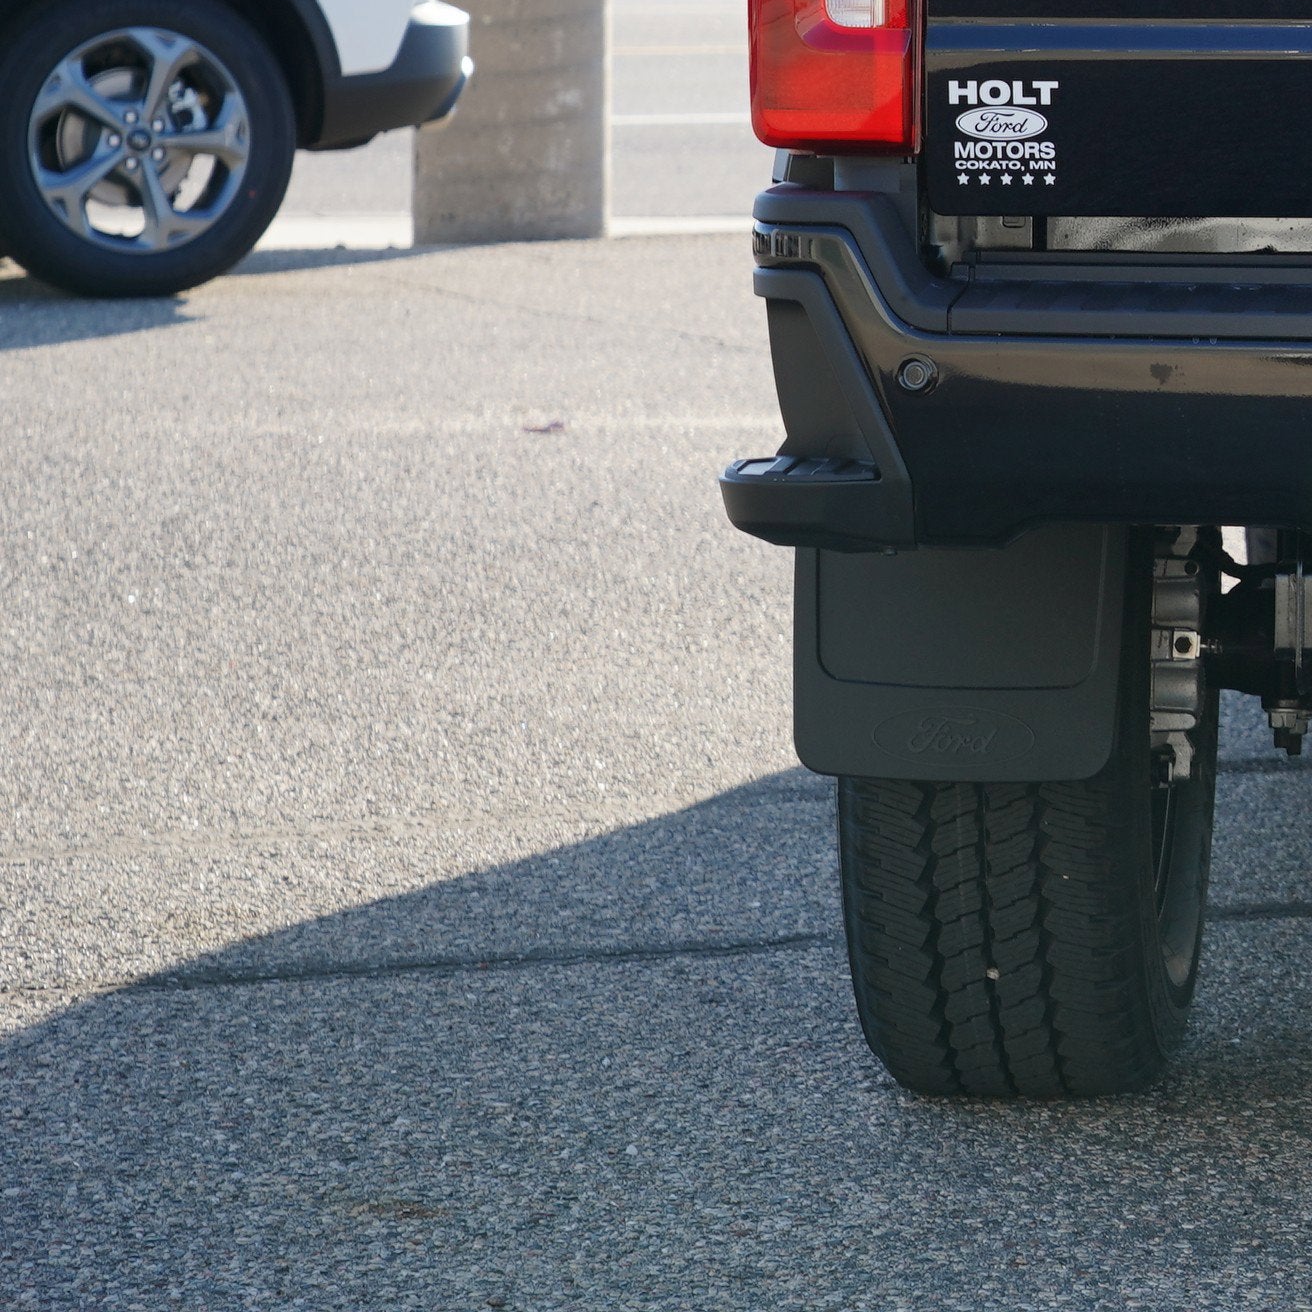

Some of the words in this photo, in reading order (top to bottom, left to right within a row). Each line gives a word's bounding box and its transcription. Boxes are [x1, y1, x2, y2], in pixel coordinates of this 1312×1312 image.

[948, 79, 1059, 106] HOLT
[974, 111, 1029, 134] Ford
[954, 141, 1056, 160] MOTORS
[955, 160, 1025, 172] COKATO,
[1029, 160, 1056, 170] MN
[908, 716, 999, 754] Ford
